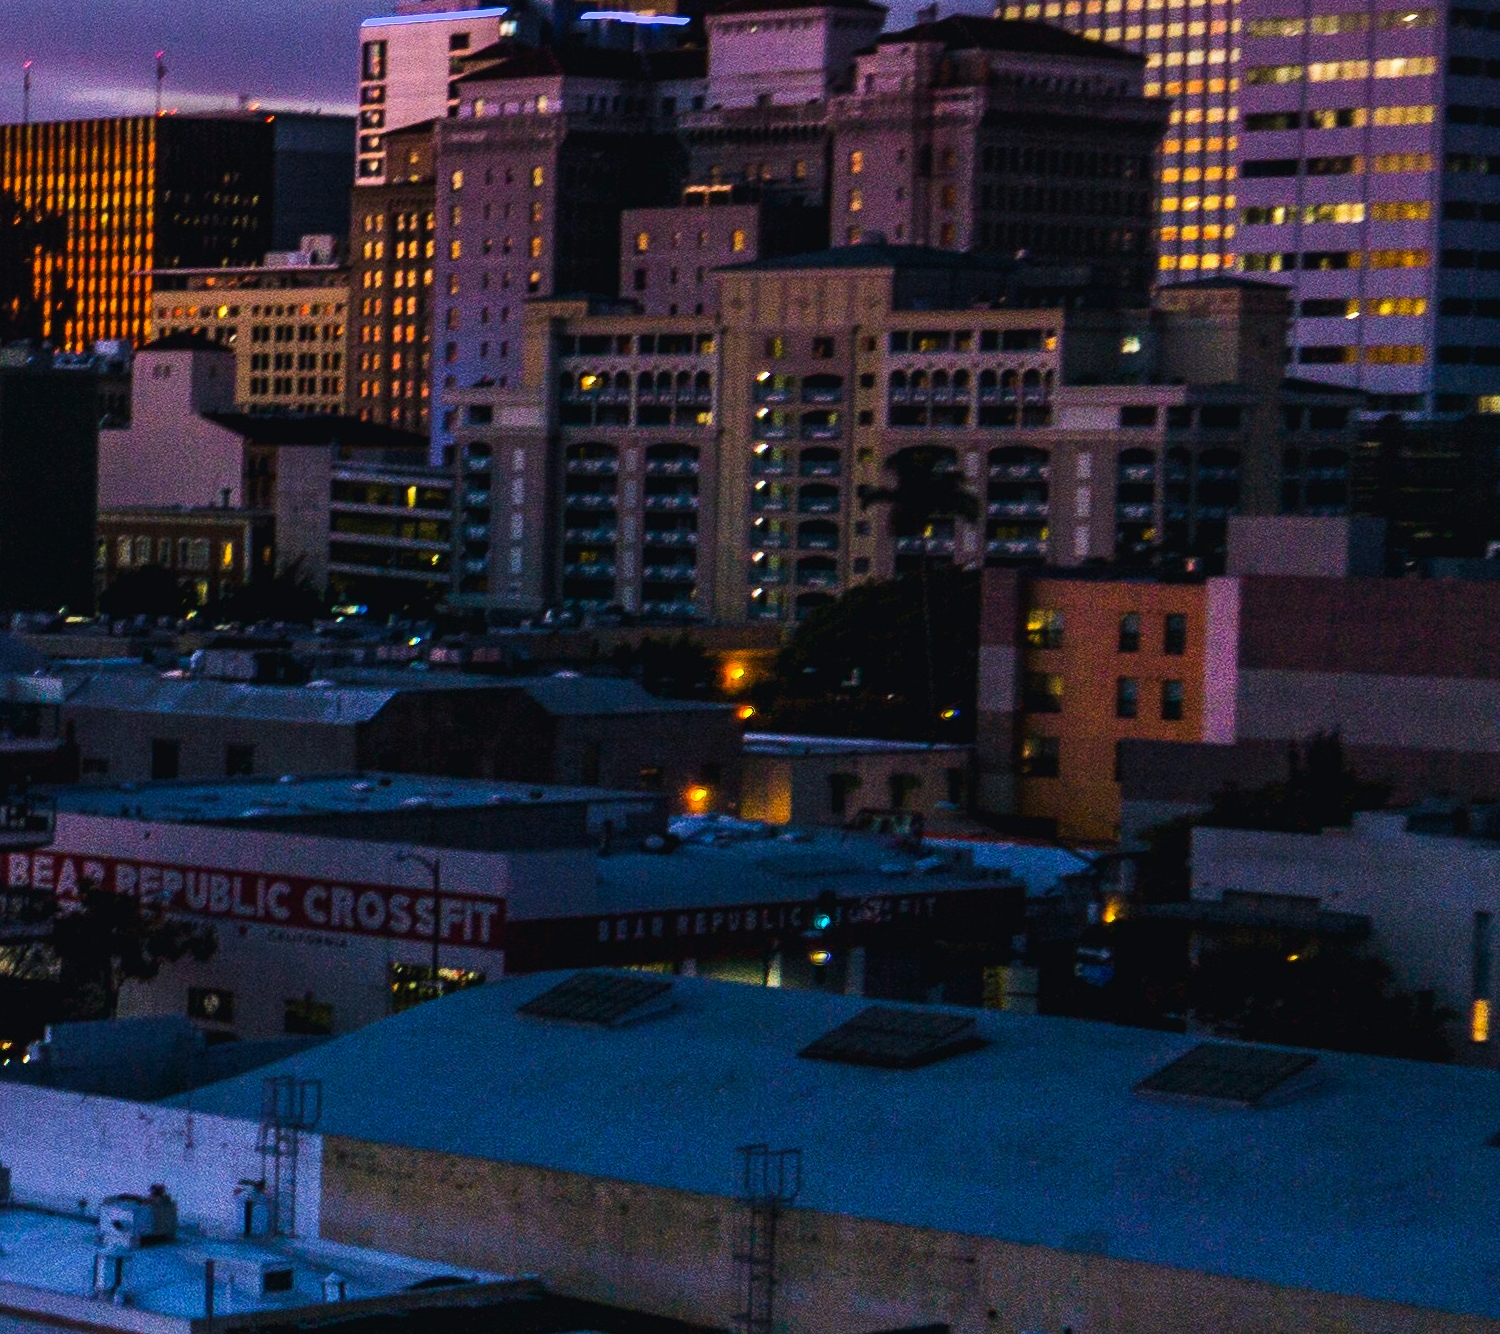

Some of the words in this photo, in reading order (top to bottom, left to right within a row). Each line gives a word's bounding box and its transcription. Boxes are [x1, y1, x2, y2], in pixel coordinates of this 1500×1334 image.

[114, 862, 293, 921] REPUBLIC
[301, 884, 499, 944] CROSSFIT
[597, 916, 665, 942] BEAR
[676, 906, 803, 935] REPUBLIC
